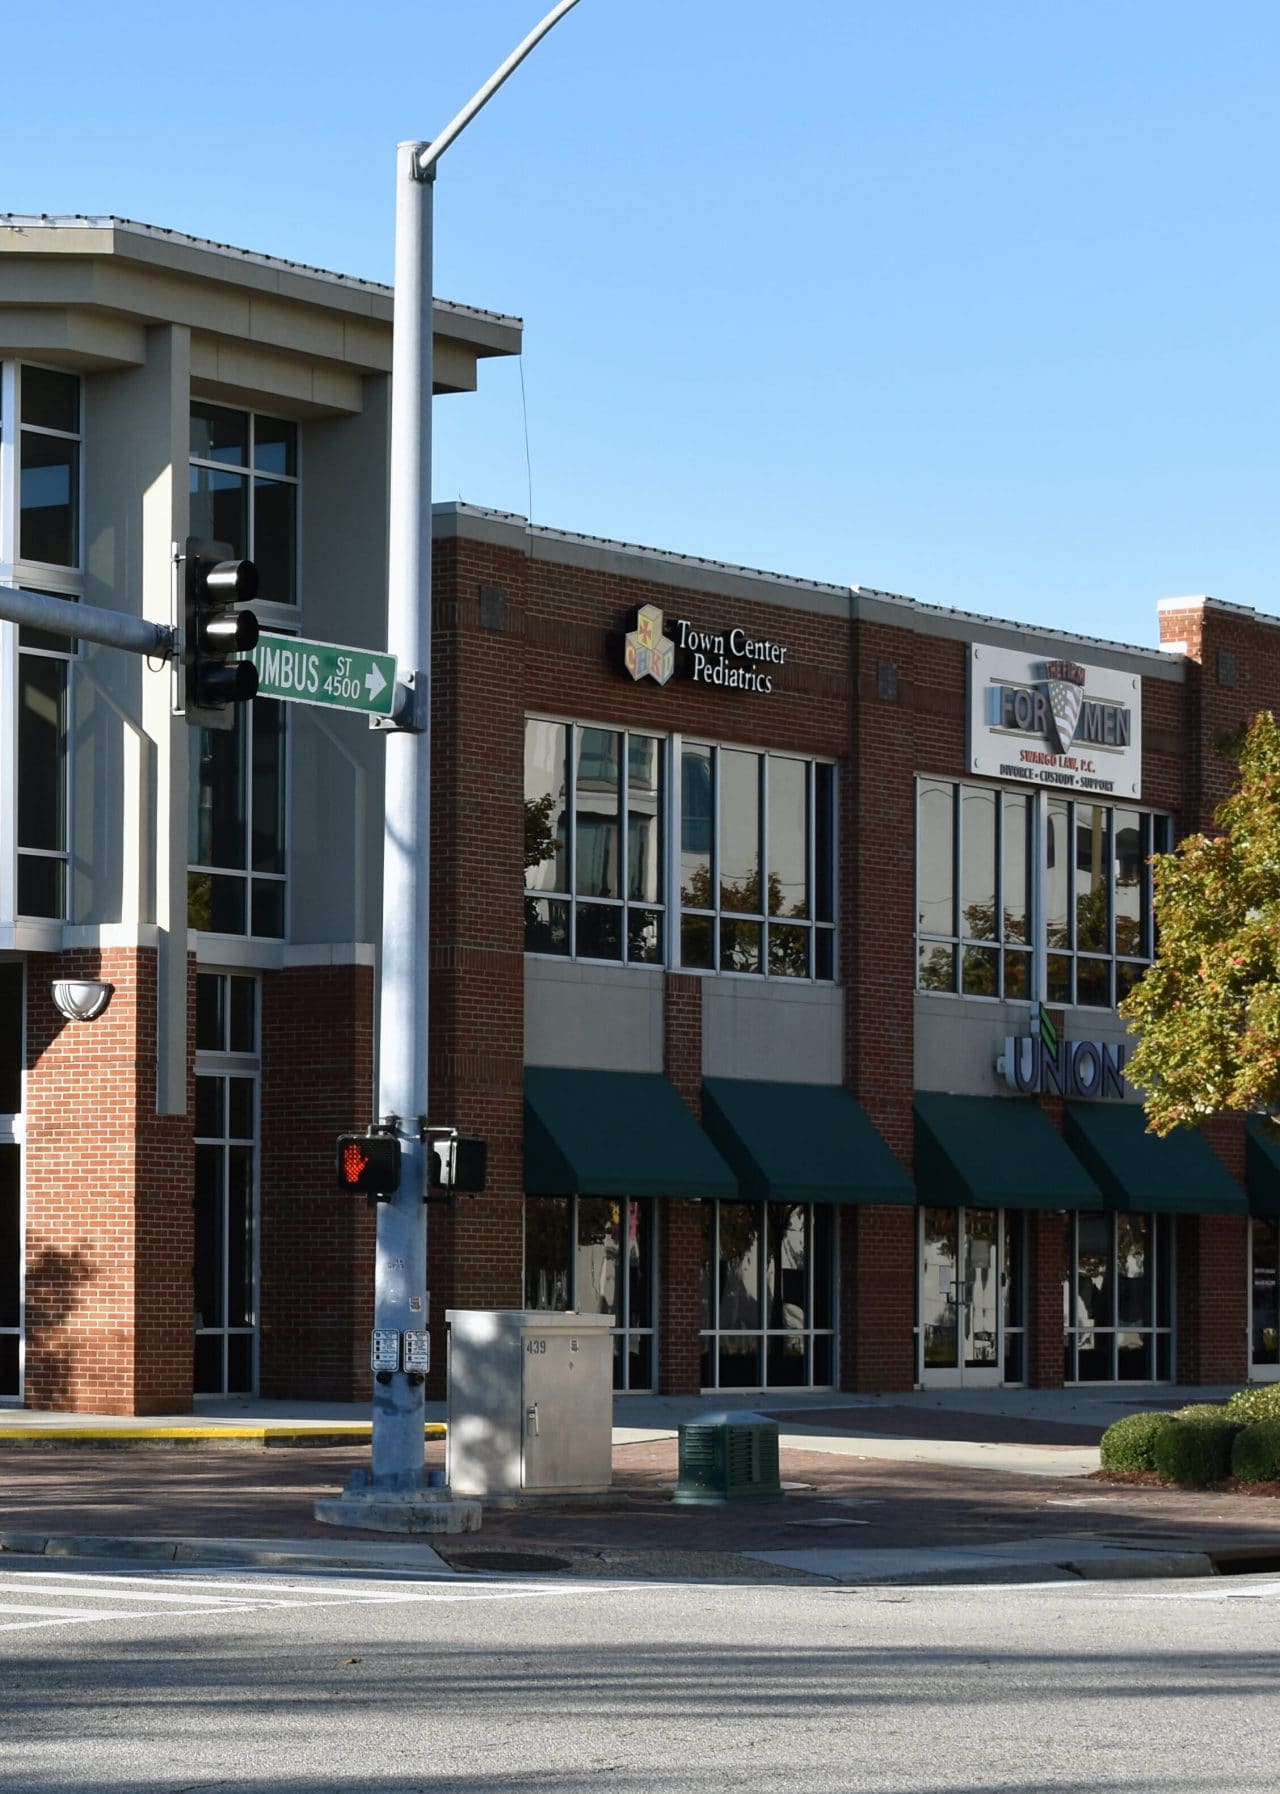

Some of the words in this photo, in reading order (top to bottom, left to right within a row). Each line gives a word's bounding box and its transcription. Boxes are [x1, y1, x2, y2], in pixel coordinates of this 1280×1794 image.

[677, 620, 724, 654] Town
[730, 628, 787, 665] Center
[236, 646, 319, 693] UMBUS
[336, 656, 353, 677] ST
[693, 653, 773, 694] Pediatrics
[323, 675, 360, 699] 4500
[1000, 686, 1048, 732] FOR
[1083, 701, 1131, 746] MEN
[999, 764, 1034, 780] DIVORCE
[1039, 770, 1075, 786] CUSTODY
[1080, 776, 1115, 792] SUPPORT
[1020, 750, 1057, 767] SWANGO
[1059, 755, 1079, 772] LAW,
[1080, 759, 1096, 773] P.C.
[1012, 1036, 1125, 1098] UNION
[526, 1340, 546, 1355] 439
